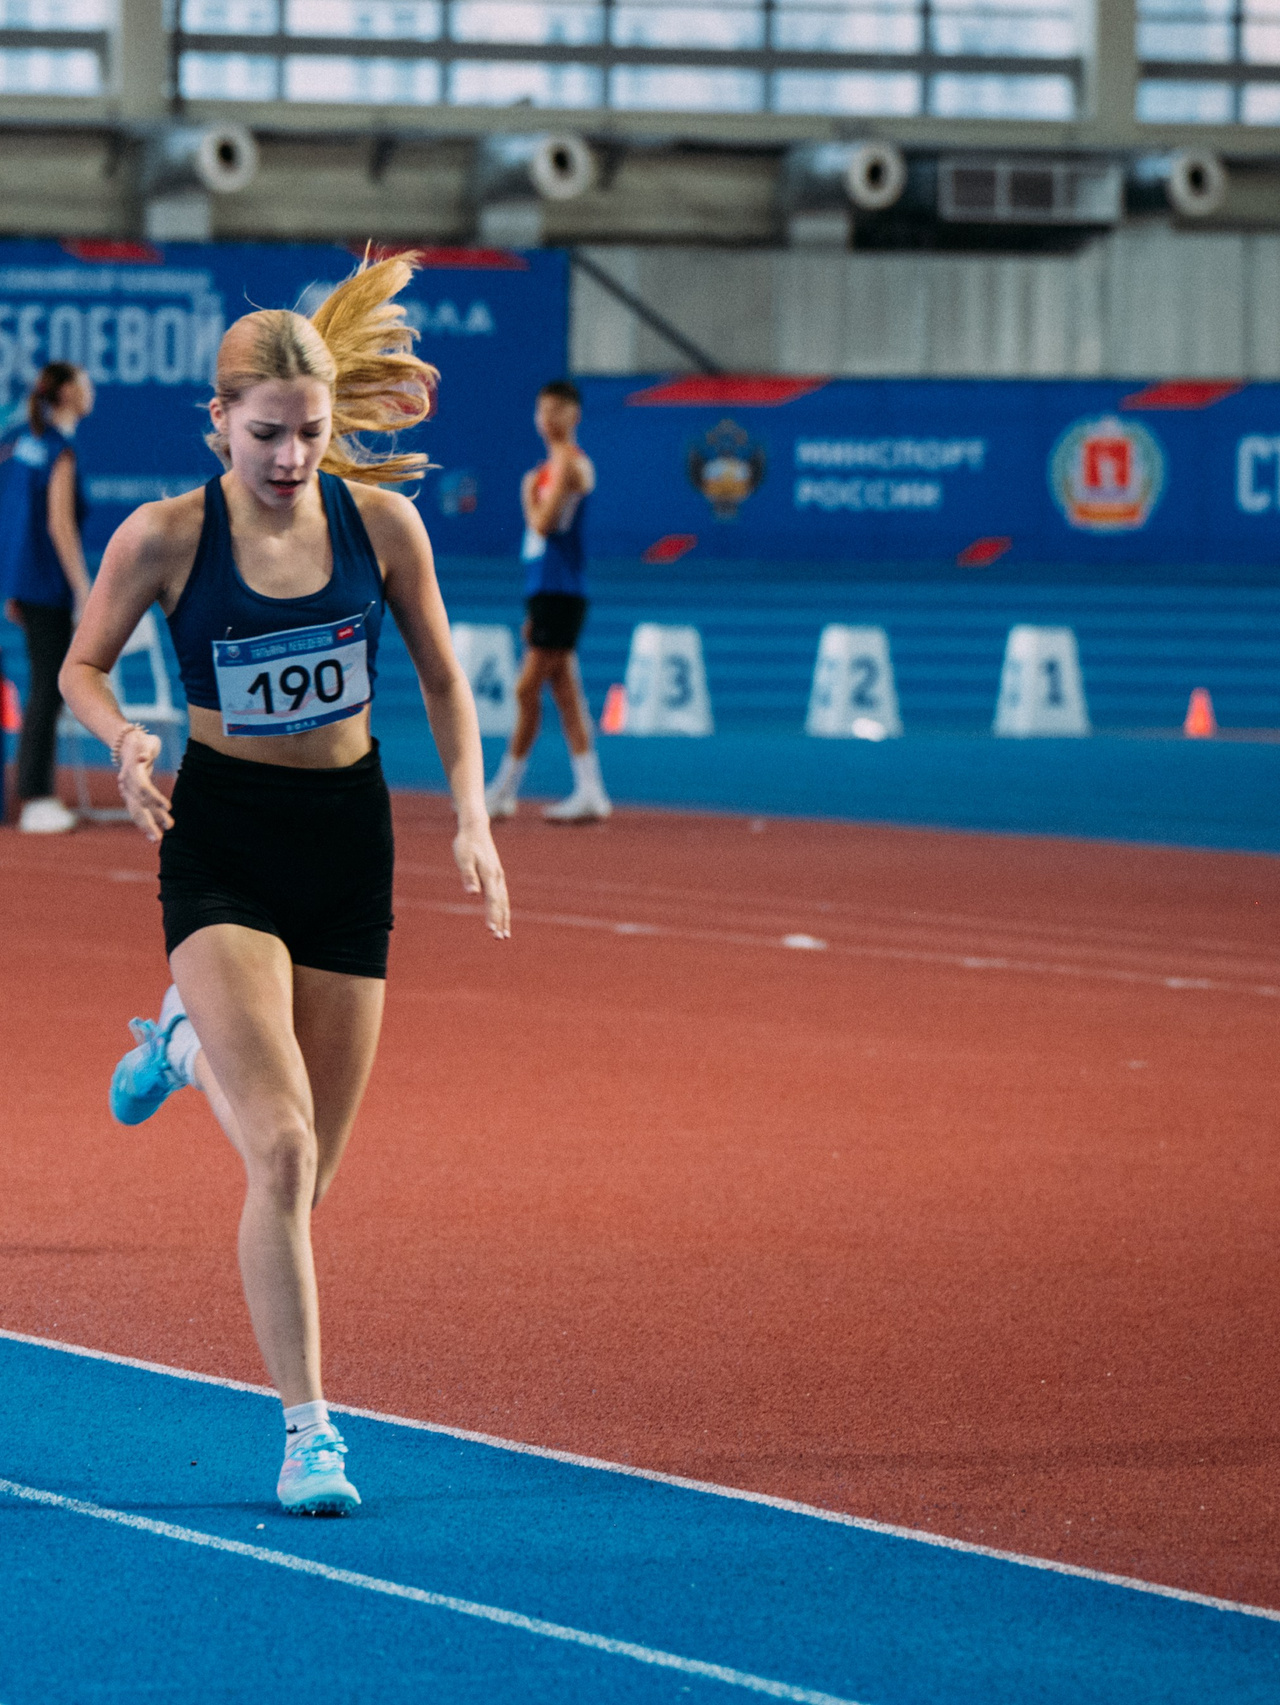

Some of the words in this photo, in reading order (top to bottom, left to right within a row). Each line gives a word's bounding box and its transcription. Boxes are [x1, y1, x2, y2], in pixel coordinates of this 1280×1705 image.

[794, 438, 986, 469] МИНСПОРТ
[1237, 436, 1280, 512] С
[794, 478, 942, 509] РОССИИ
[247, 658, 344, 714] 190
[474, 654, 503, 706] 4
[663, 653, 693, 710] 3
[849, 654, 879, 710] 2
[1042, 656, 1063, 709] 1
